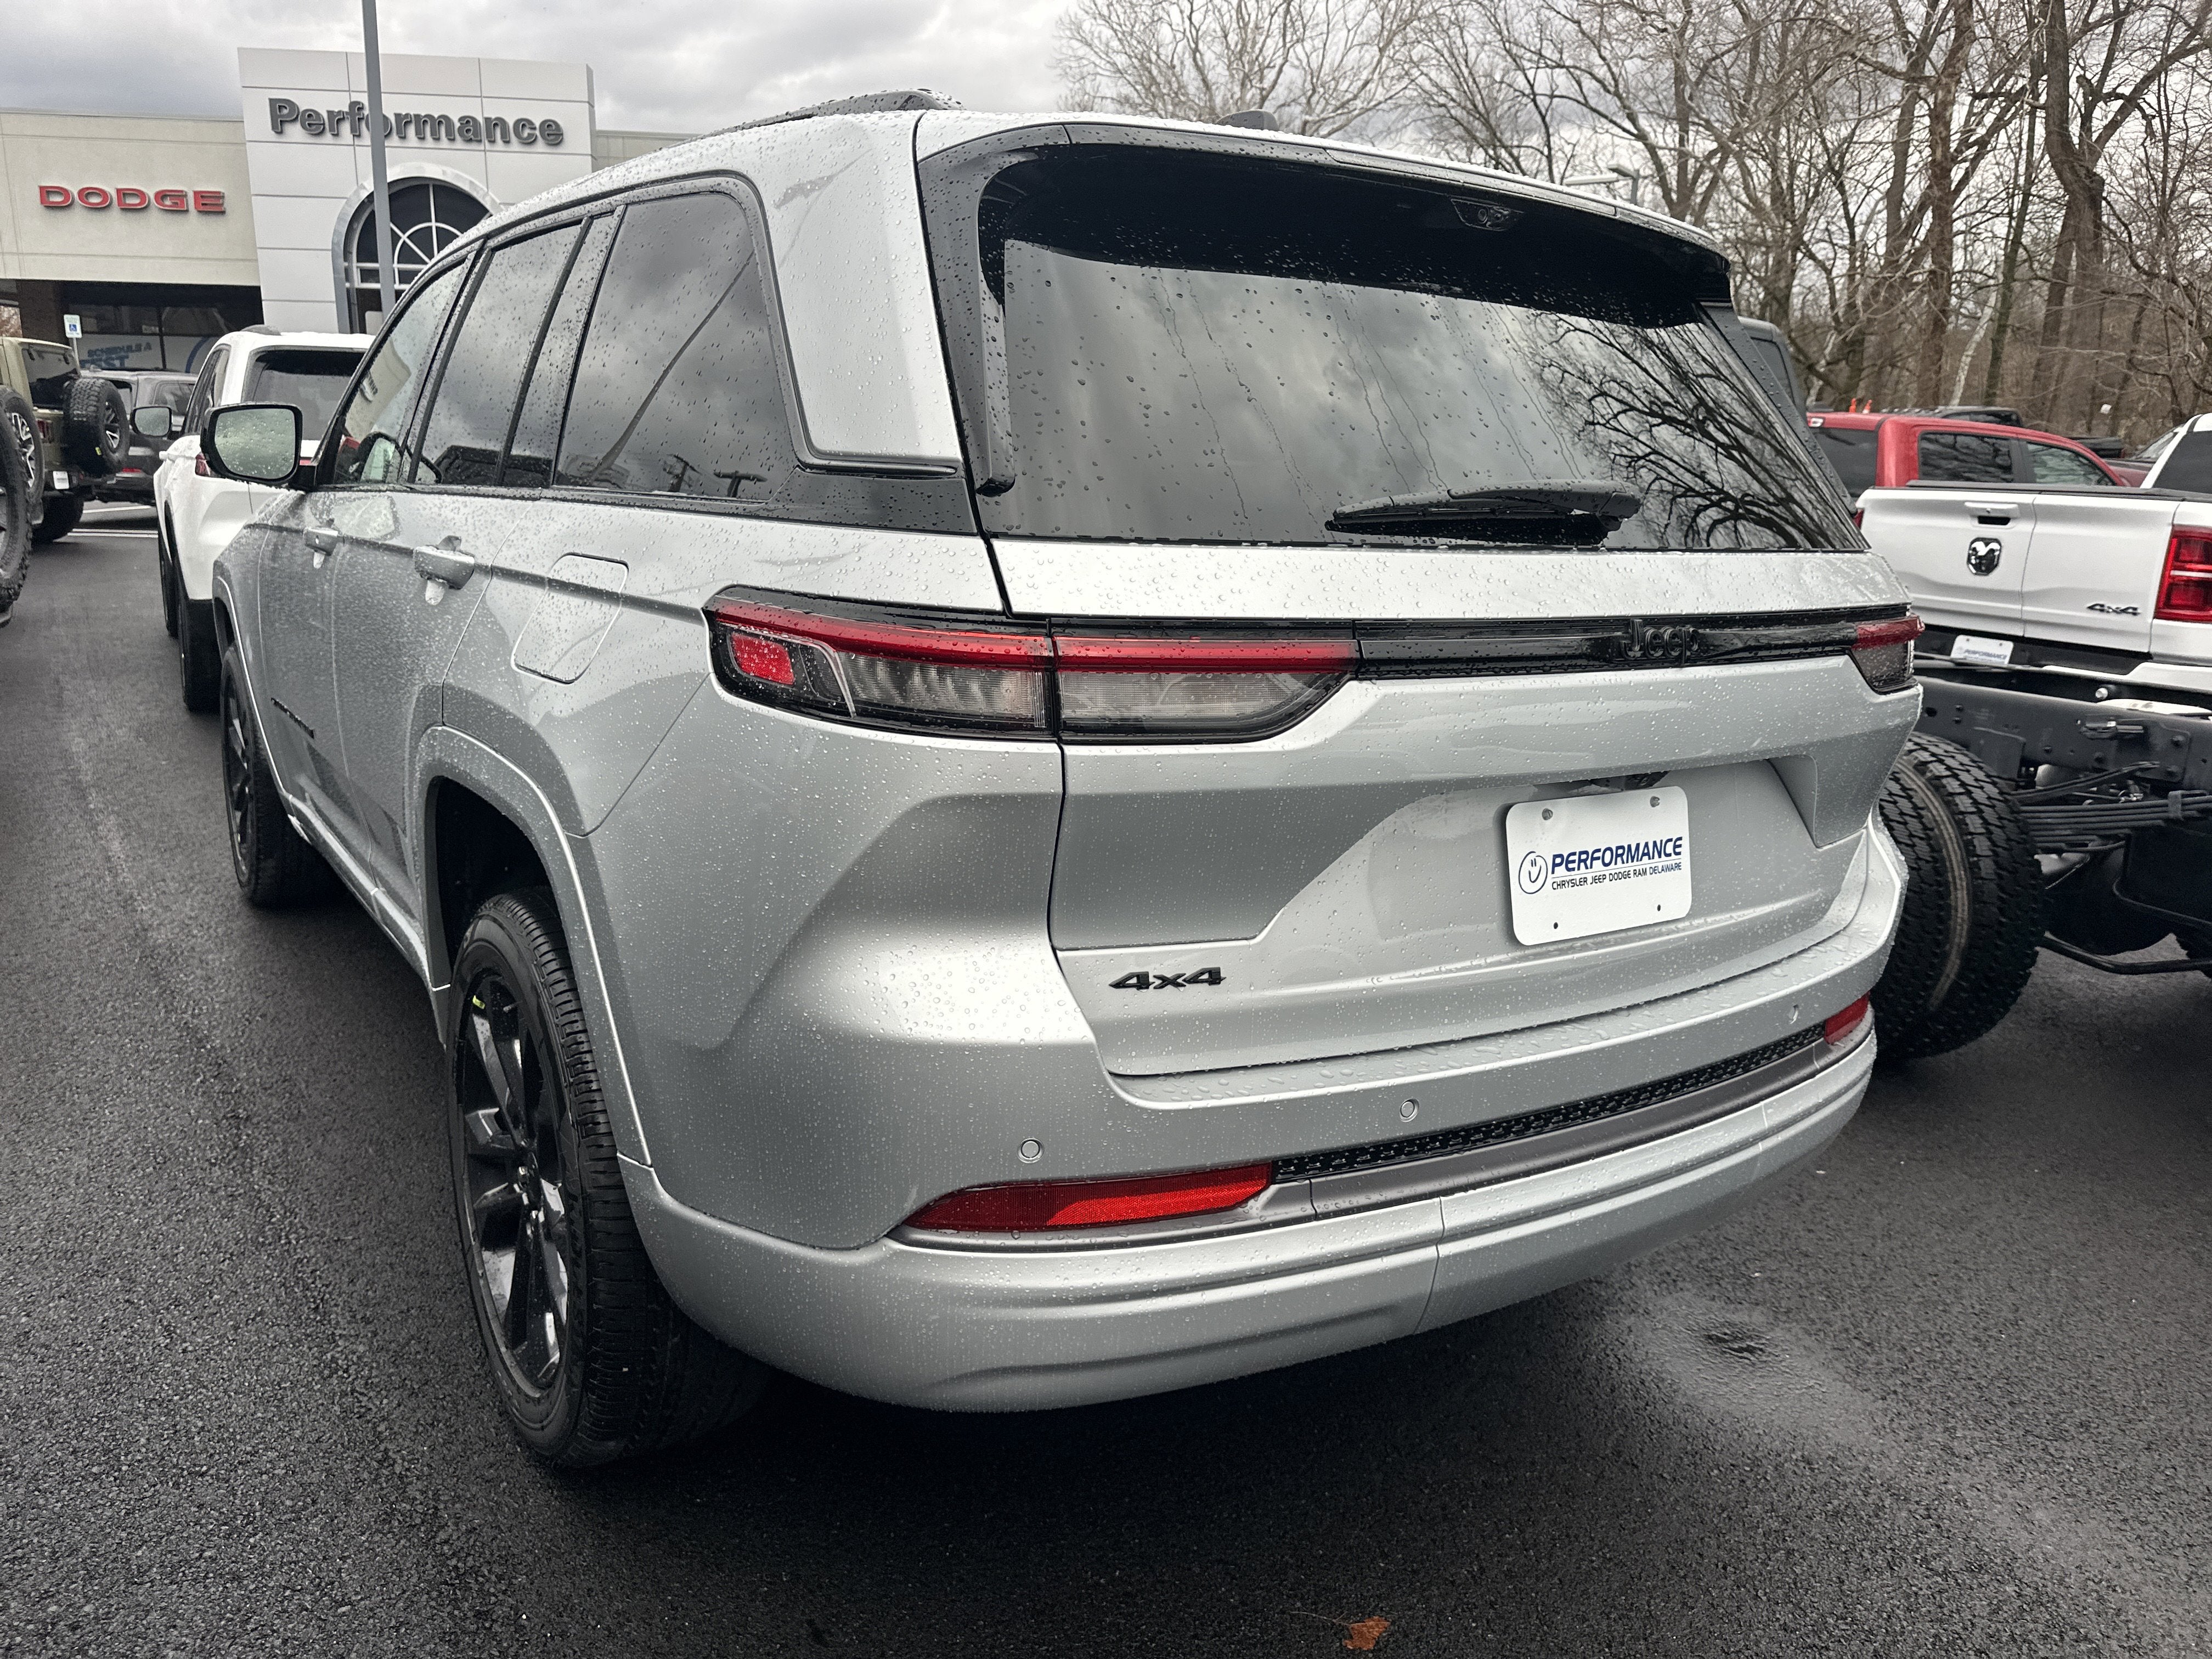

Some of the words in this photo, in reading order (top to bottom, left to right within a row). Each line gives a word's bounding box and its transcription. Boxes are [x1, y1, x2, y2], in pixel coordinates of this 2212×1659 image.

[38, 185, 226, 215] DODGE
[2086, 603, 2141, 616] 4x4
[1620, 619, 1699, 665] Jeep
[1551, 836, 1683, 874] PERFORMANCE
[1551, 874, 1588, 890] CHRYSLER
[1590, 873, 1606, 884] JEEP
[1609, 870, 1631, 881] DODGE
[1633, 867, 1647, 877] RAM
[1649, 861, 1682, 875] DELAWARE
[1108, 967, 1226, 990] 4x4
